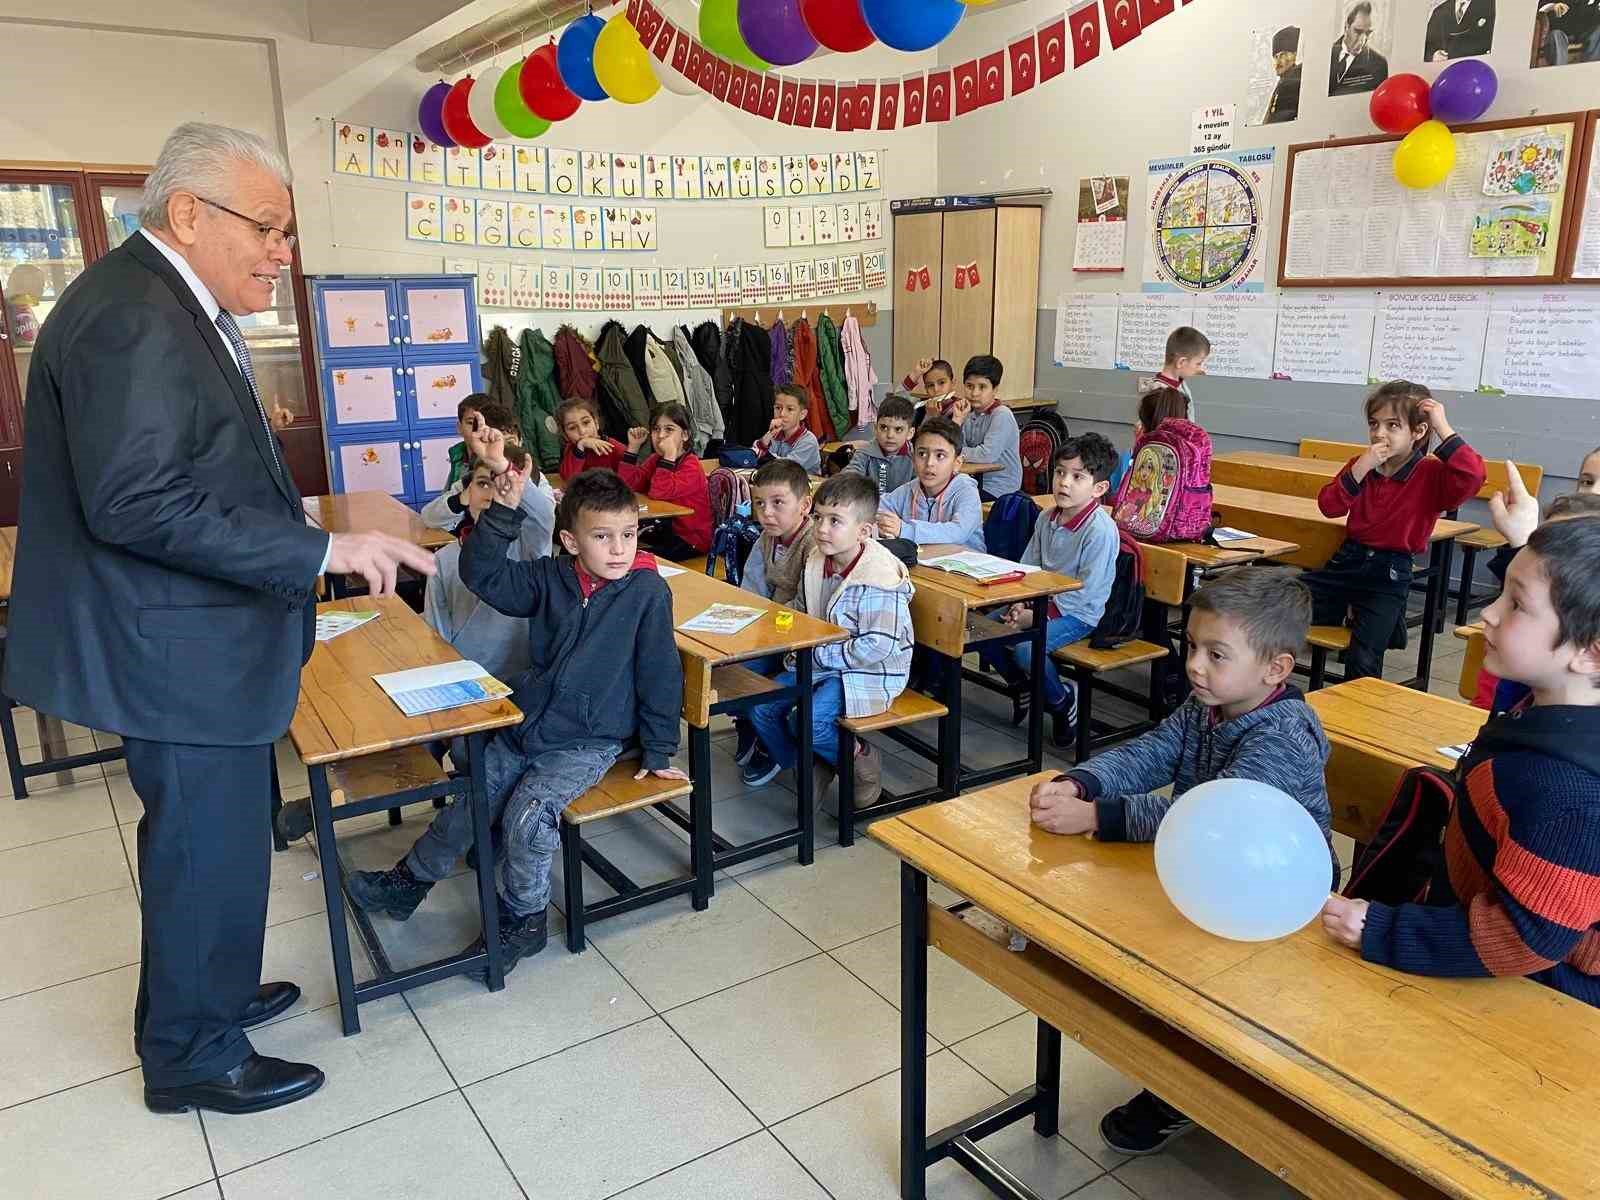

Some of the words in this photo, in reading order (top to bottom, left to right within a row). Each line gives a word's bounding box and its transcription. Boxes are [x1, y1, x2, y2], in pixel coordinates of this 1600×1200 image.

[1212, 108, 1224, 117] YIL
[1203, 120, 1229, 130] mevsim
[1213, 133, 1221, 141] ay
[1193, 145, 1206, 153] 365
[1207, 143, 1230, 153] gündür
[1239, 153, 1271, 163] TABLOSU
[345, 153, 361, 173] A
[383, 158, 399, 177] N
[423, 162, 433, 181] E
[457, 166, 469, 186] T
[527, 173, 537, 192] L
[556, 175, 572, 193] O
[592, 177, 604, 196] K
[622, 178, 635, 197] U
[655, 179, 664, 197] R
[687, 180, 690, 197] I
[709, 180, 724, 197] M
[739, 175, 750, 197] Ü
[766, 179, 775, 196] S
[790, 172, 803, 195] Ö
[815, 176, 825, 193] Y
[840, 175, 851, 191] D
[864, 172, 873, 189] Z
[773, 211, 781, 225] 0
[797, 211, 801, 224] 1
[820, 210, 827, 223] 2
[843, 208, 850, 221] 3
[864, 207, 871, 218] 4
[417, 219, 432, 239] Ç
[455, 223, 465, 242] B
[485, 226, 501, 244] G
[518, 228, 533, 246] C
[584, 231, 594, 249] P
[611, 232, 624, 249] H
[637, 232, 650, 249] V
[486, 267, 496, 281] 6
[519, 269, 527, 283] 7
[549, 271, 558, 285] 8
[580, 272, 588, 286] 9
[607, 273, 621, 287] 10
[640, 273, 649, 287] 11
[665, 273, 678, 287] 12
[693, 272, 705, 286] 13
[719, 271, 731, 285] 14
[745, 270, 757, 283] 15
[771, 268, 782, 282] 16
[795, 265, 806, 279] 17
[820, 262, 829, 276] 18
[843, 259, 852, 273] 19
[865, 255, 879, 269] 20
